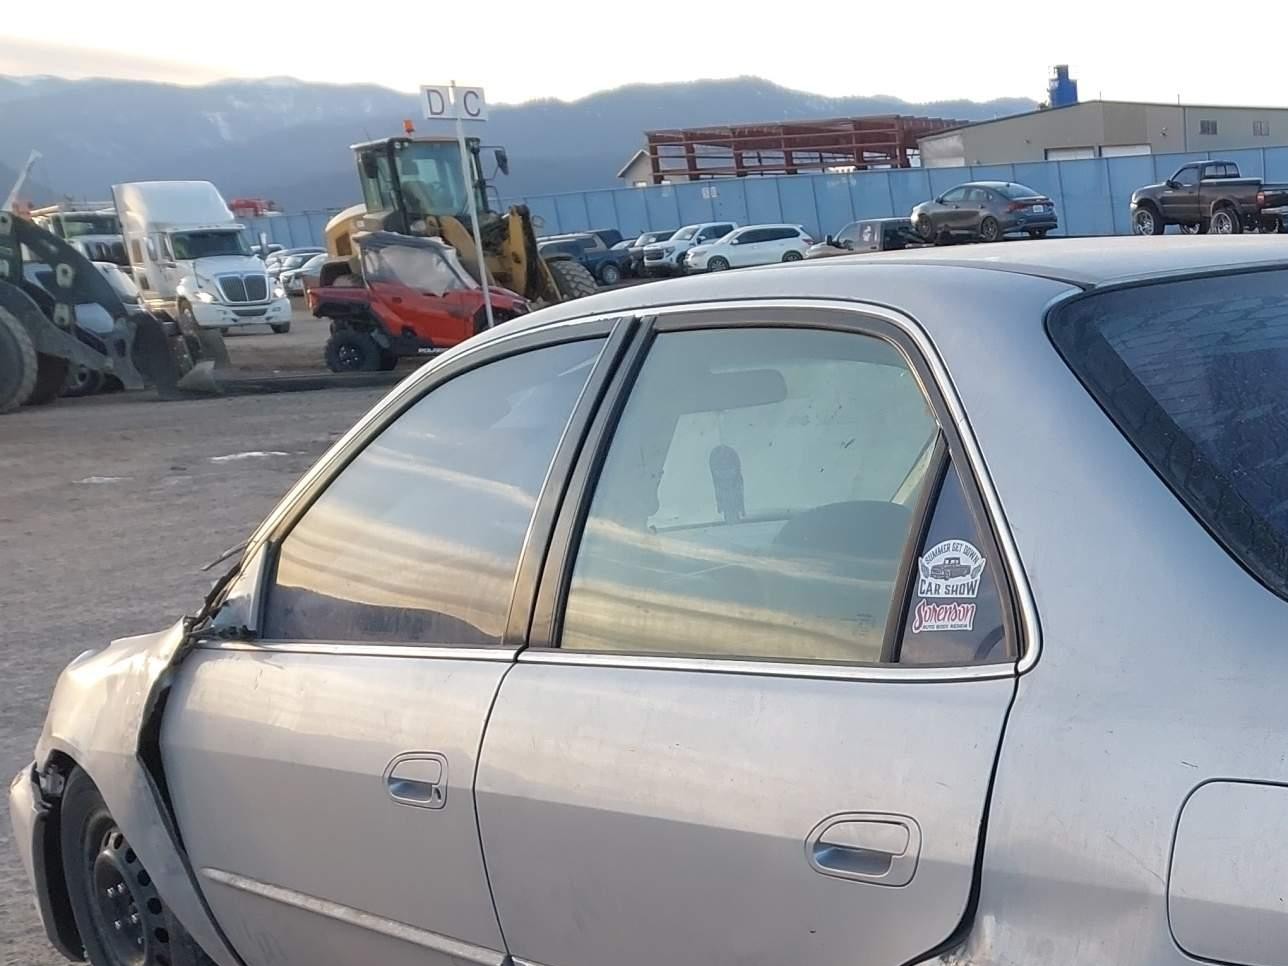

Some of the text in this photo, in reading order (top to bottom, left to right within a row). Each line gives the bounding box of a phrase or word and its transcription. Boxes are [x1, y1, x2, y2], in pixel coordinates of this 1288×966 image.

[426, 88, 445, 116] D
[463, 90, 481, 117] C
[925, 542, 981, 565] SUMMER GET DOWN
[919, 579, 978, 596] CAR SHOW
[914, 601, 975, 631] Sorenson
